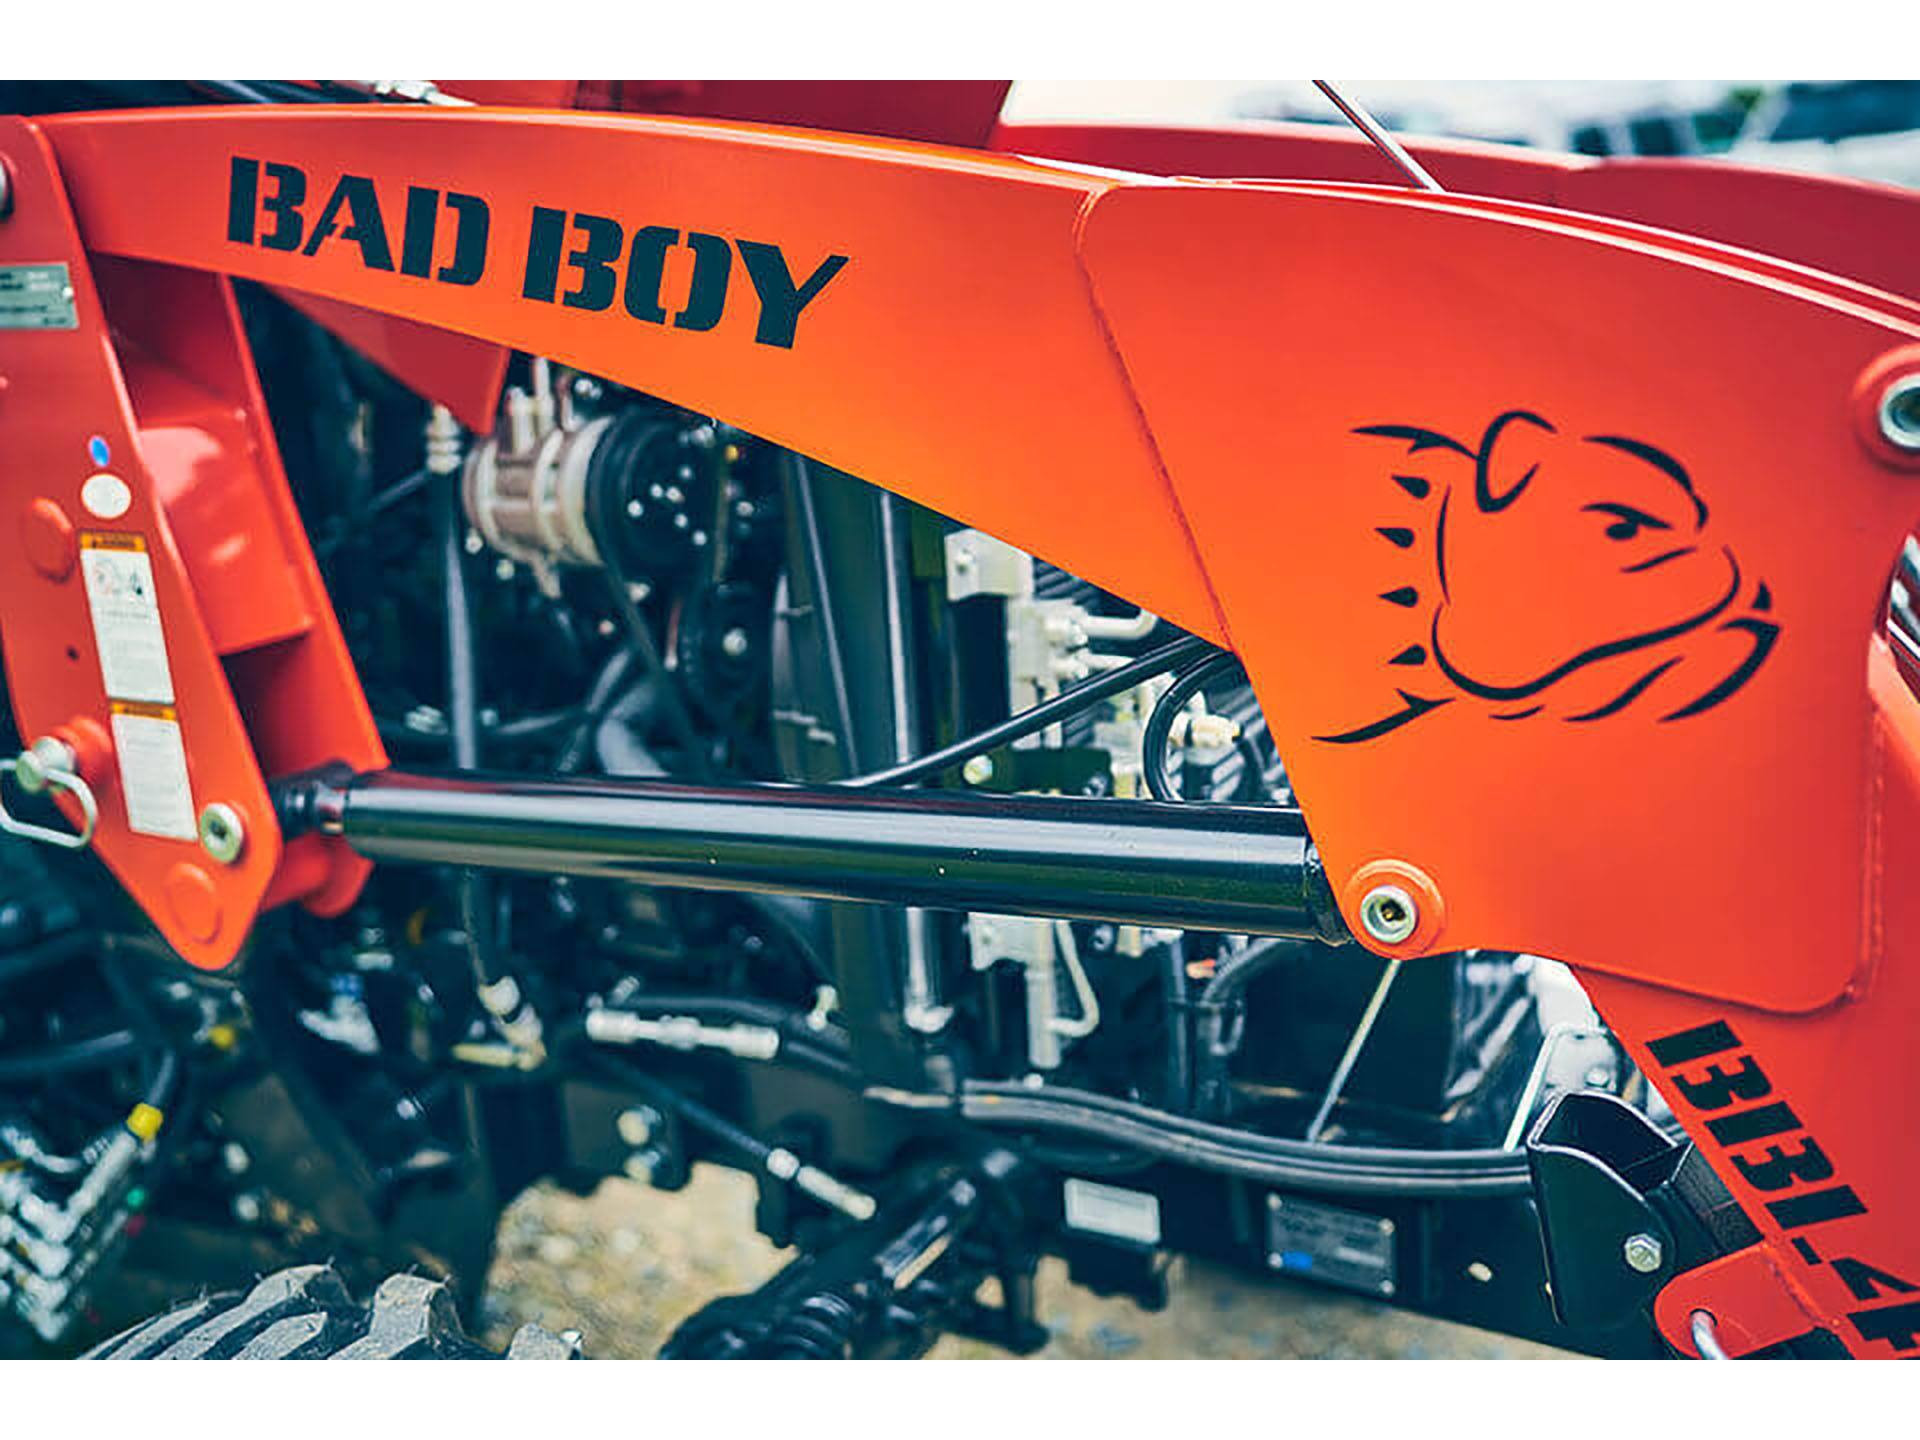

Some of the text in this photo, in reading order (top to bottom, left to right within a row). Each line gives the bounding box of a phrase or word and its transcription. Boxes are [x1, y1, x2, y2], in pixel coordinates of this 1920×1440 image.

[227, 156, 850, 350] BAD BOY
[1644, 1019, 1920, 1360] BBL4
